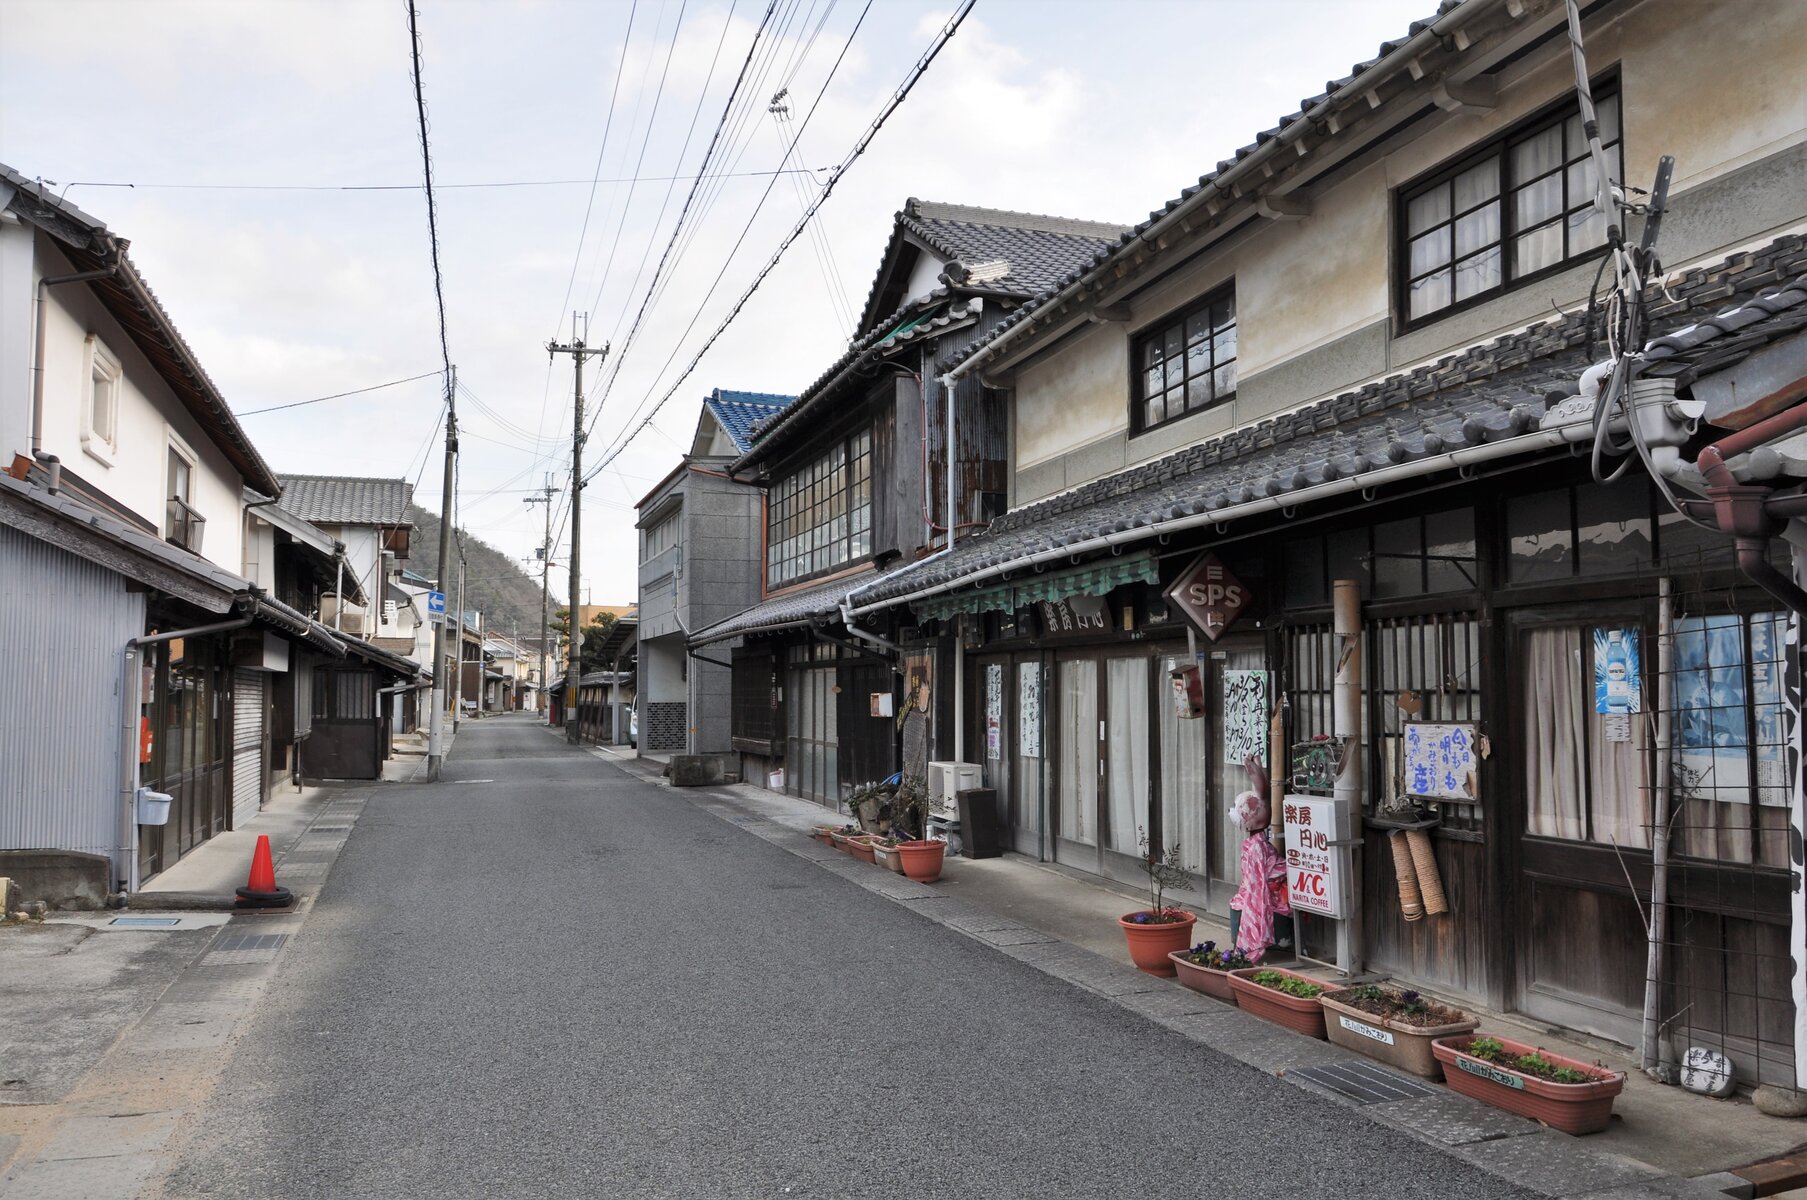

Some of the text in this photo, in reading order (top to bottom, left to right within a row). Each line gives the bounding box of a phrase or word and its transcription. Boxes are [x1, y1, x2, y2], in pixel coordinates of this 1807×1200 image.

[1189, 583, 1242, 608] SPS
[1284, 804, 1312, 826] 楽房
[1299, 828, 1329, 852] 円心
[1292, 892, 1329, 909] NARITA COFFEE
